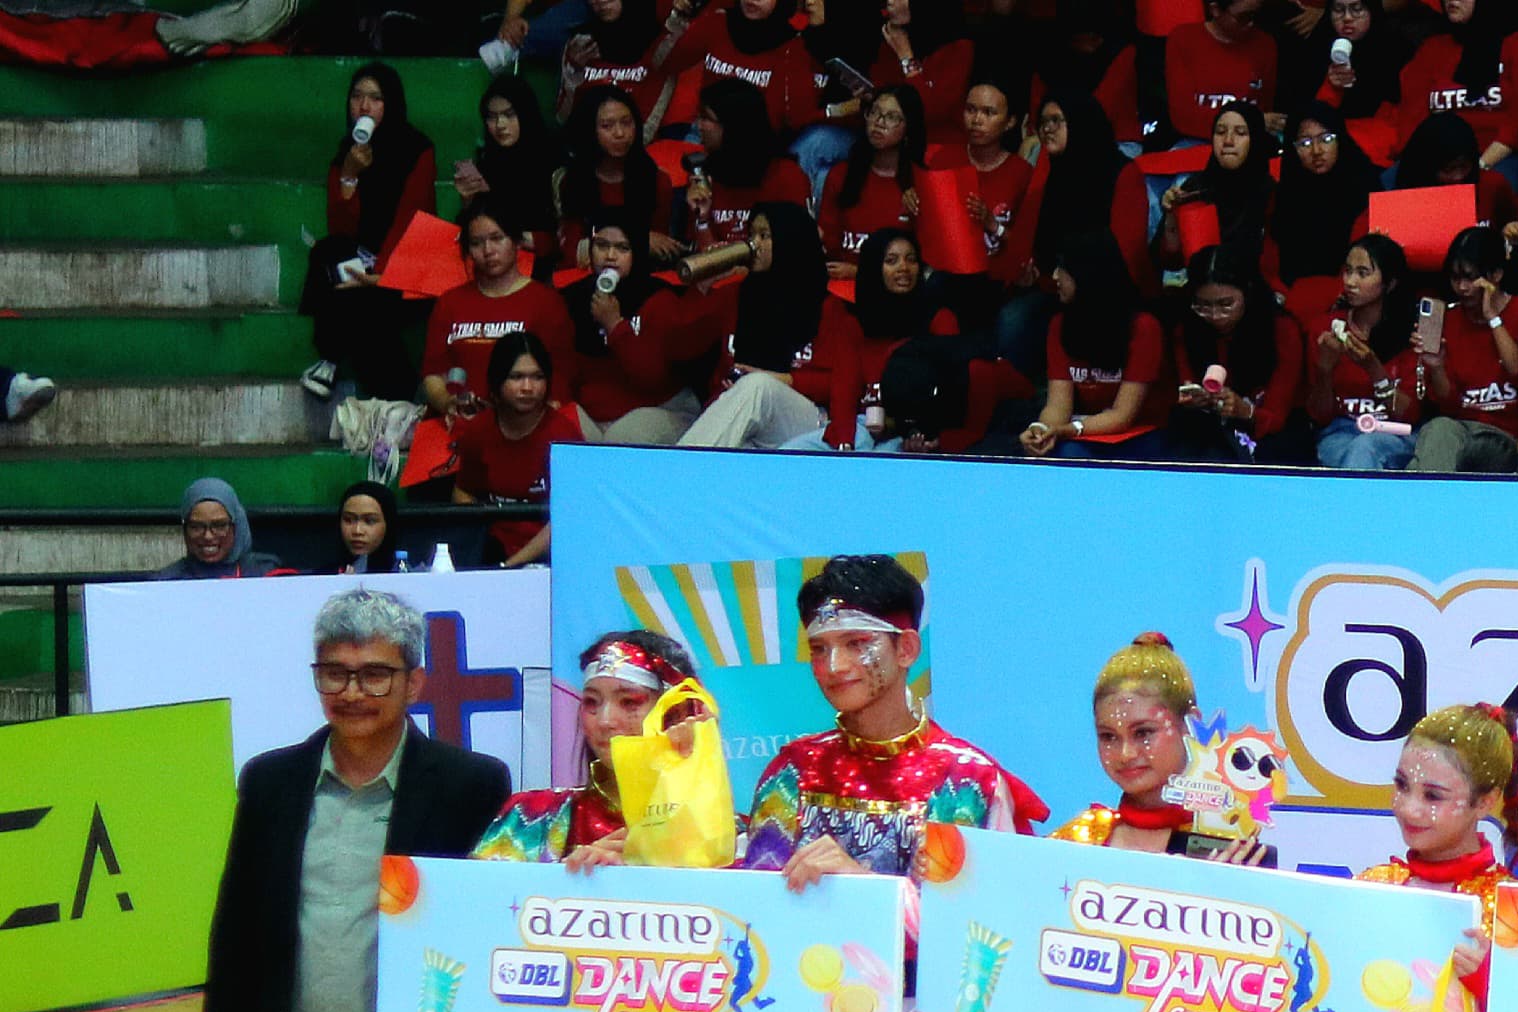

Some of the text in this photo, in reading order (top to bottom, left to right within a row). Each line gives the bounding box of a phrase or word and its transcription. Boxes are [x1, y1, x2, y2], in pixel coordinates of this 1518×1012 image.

[528, 906, 713, 945] azarine
[1079, 889, 1275, 949] azarine
[518, 962, 561, 989] DBL
[1067, 948, 1114, 975] DBL
